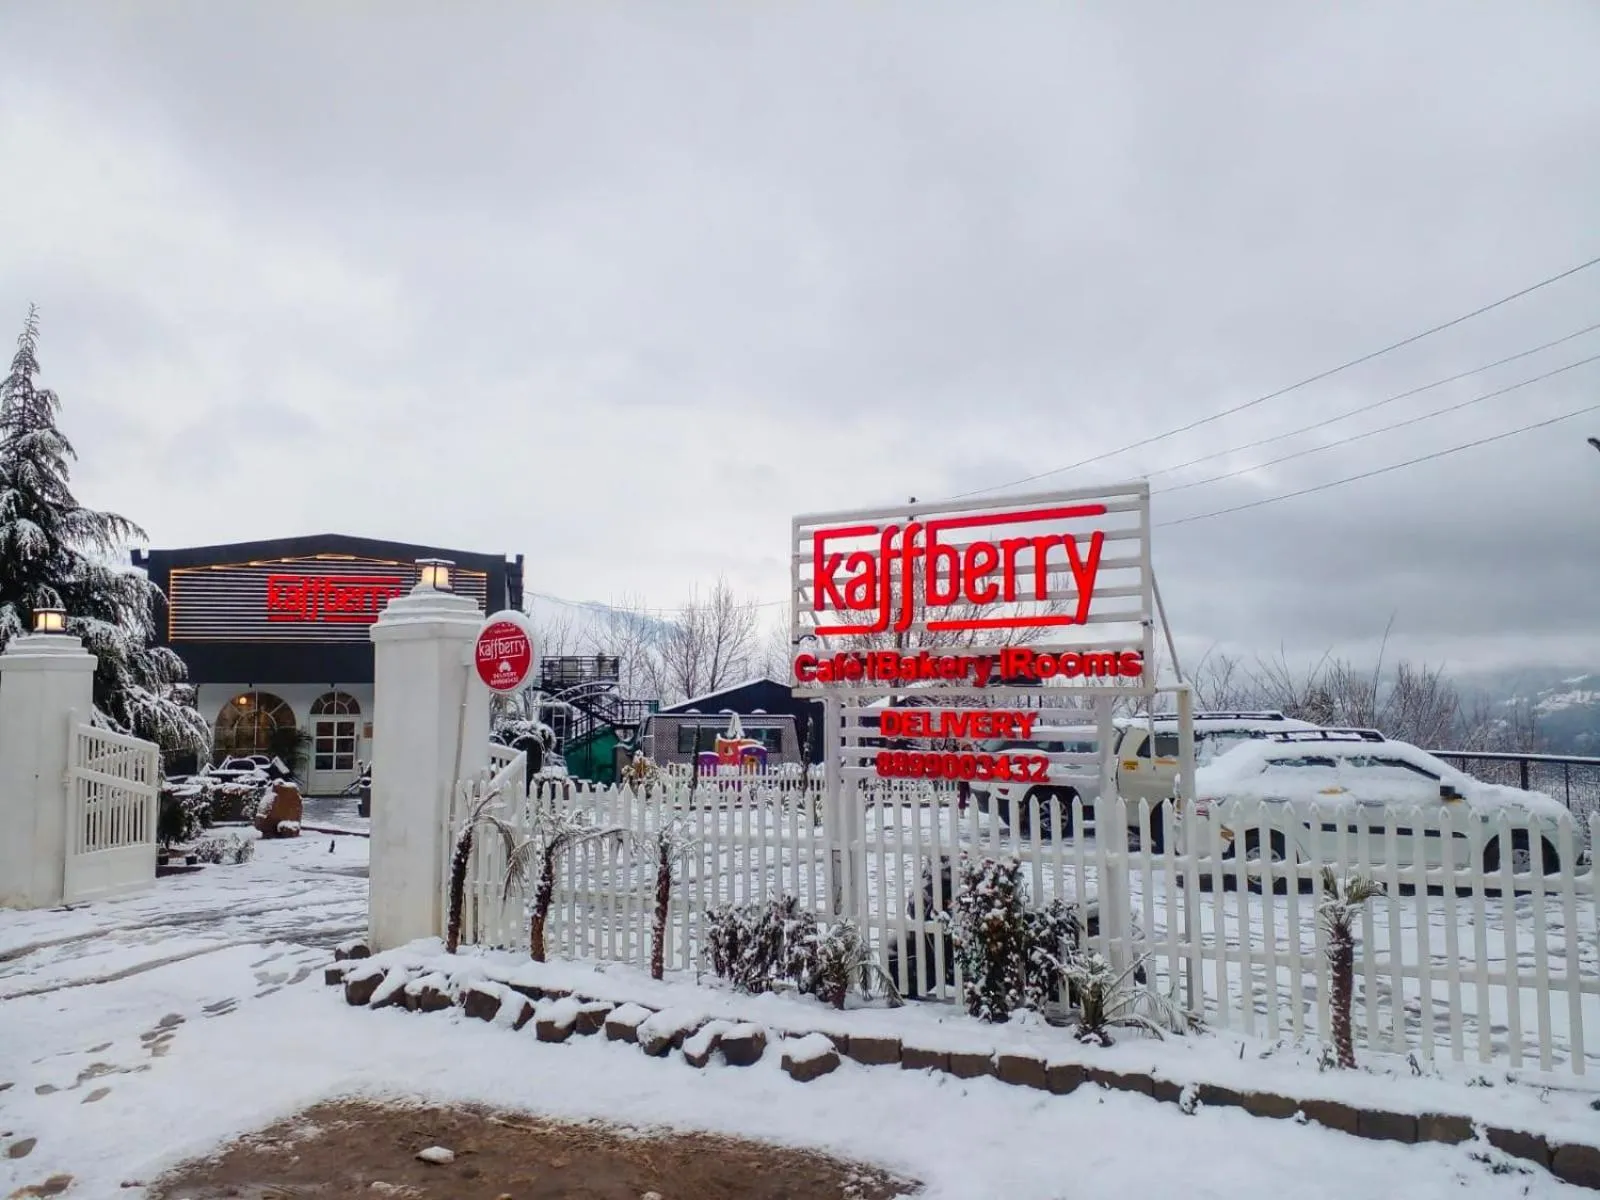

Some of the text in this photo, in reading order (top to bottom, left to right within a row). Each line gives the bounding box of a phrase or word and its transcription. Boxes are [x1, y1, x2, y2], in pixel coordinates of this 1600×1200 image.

[813, 504, 1106, 635] kaffberry
[478, 635, 525, 661] kaffberry
[880, 710, 1038, 740] DELIVERY
[875, 751, 1050, 783] 8899003432
